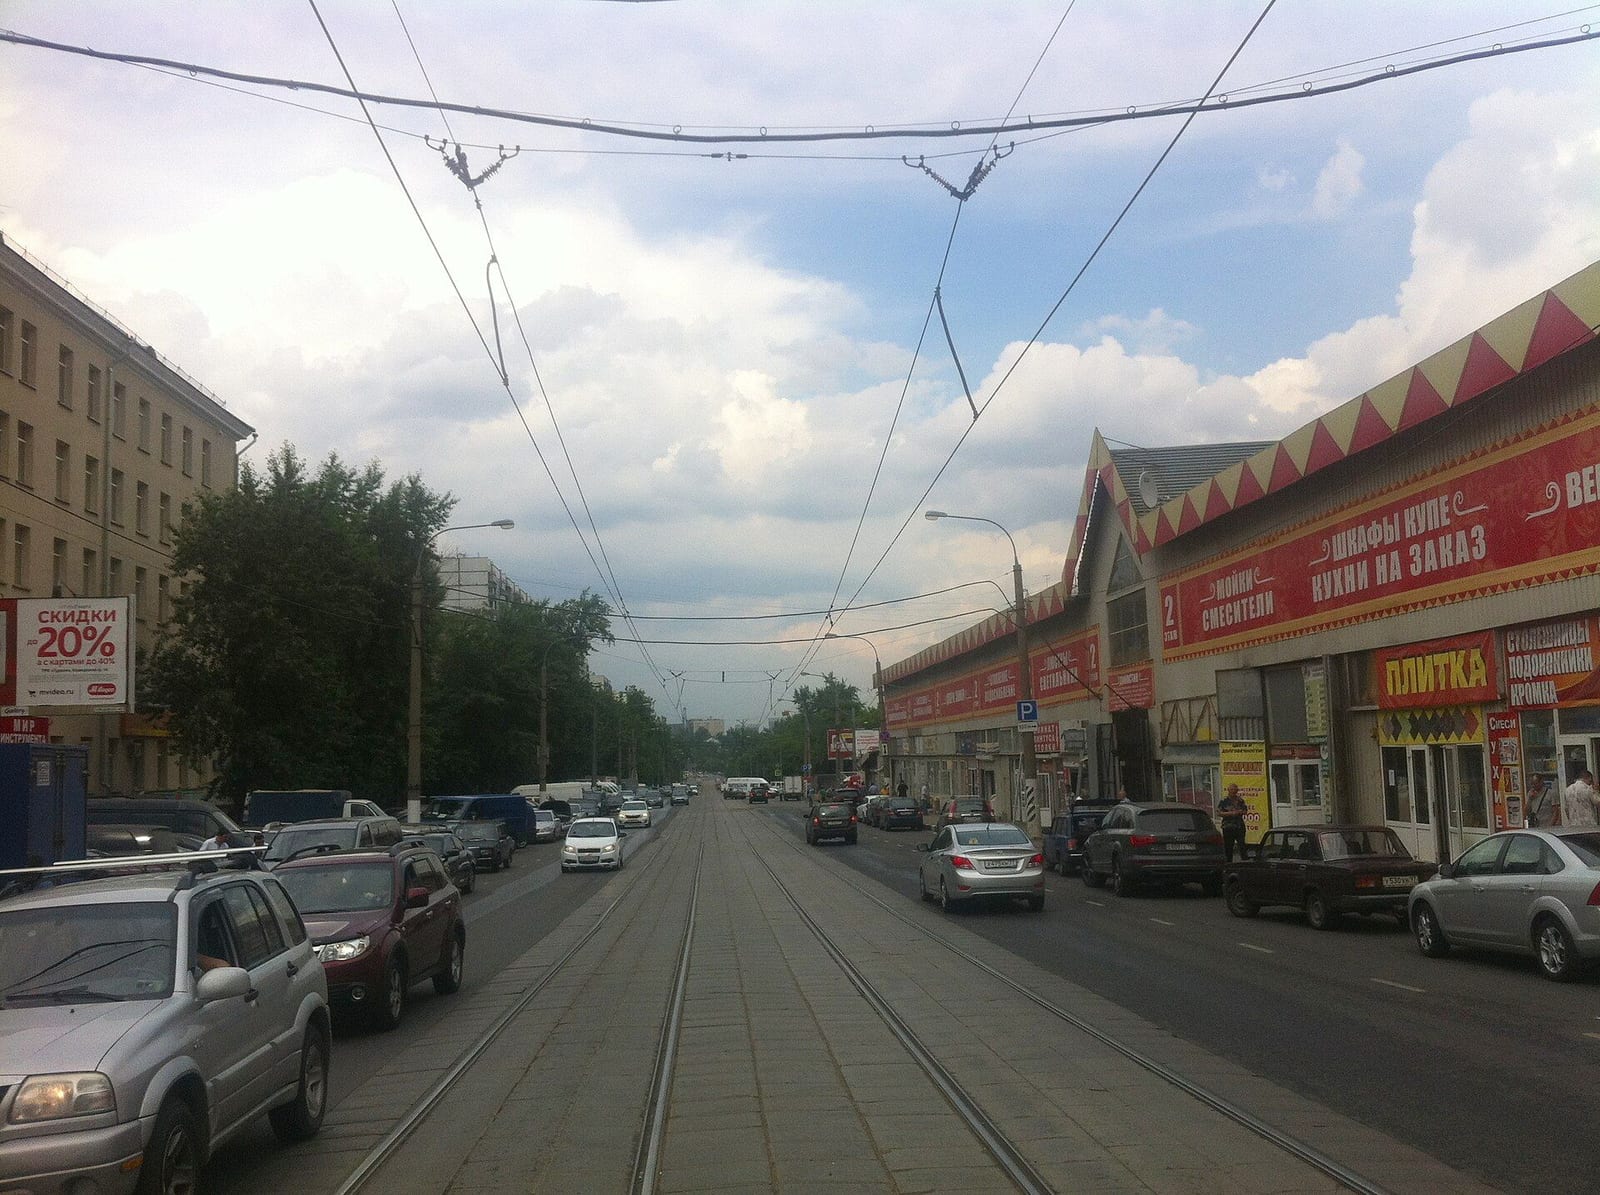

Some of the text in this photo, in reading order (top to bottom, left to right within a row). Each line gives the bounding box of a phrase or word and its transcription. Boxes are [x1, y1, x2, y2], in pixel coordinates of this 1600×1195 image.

[1332, 495, 1451, 562] ШКАФЫ КУПЕ
[1312, 525, 1487, 603] КУХНИ НА ЗАКАЗ
[1216, 568, 1254, 601] МОЙКИ
[38, 610, 116, 625] СКИДКИ
[1164, 595, 1175, 627] 2
[1202, 591, 1274, 633] СМЕСИТЕЛИ
[37, 626, 115, 658] 20%
[1507, 619, 1590, 653] СТОЛЕШНИЦЫ
[50, 659, 84, 668] картами
[86, 659, 95, 667] до
[97, 656, 115, 665] 40%
[1090, 643, 1097, 669] 2
[1386, 648, 1487, 696] ПЛИТКА
[1508, 647, 1593, 681] ПОДОКОННИКИ
[39, 688, 74, 696] mvideo.ru
[1510, 680, 1558, 706] КРОМКА
[13, 718, 35, 732] МИР
[1021, 703, 1033, 720] P
[0, 732, 46, 744] ИНСТРУМЕНТА
